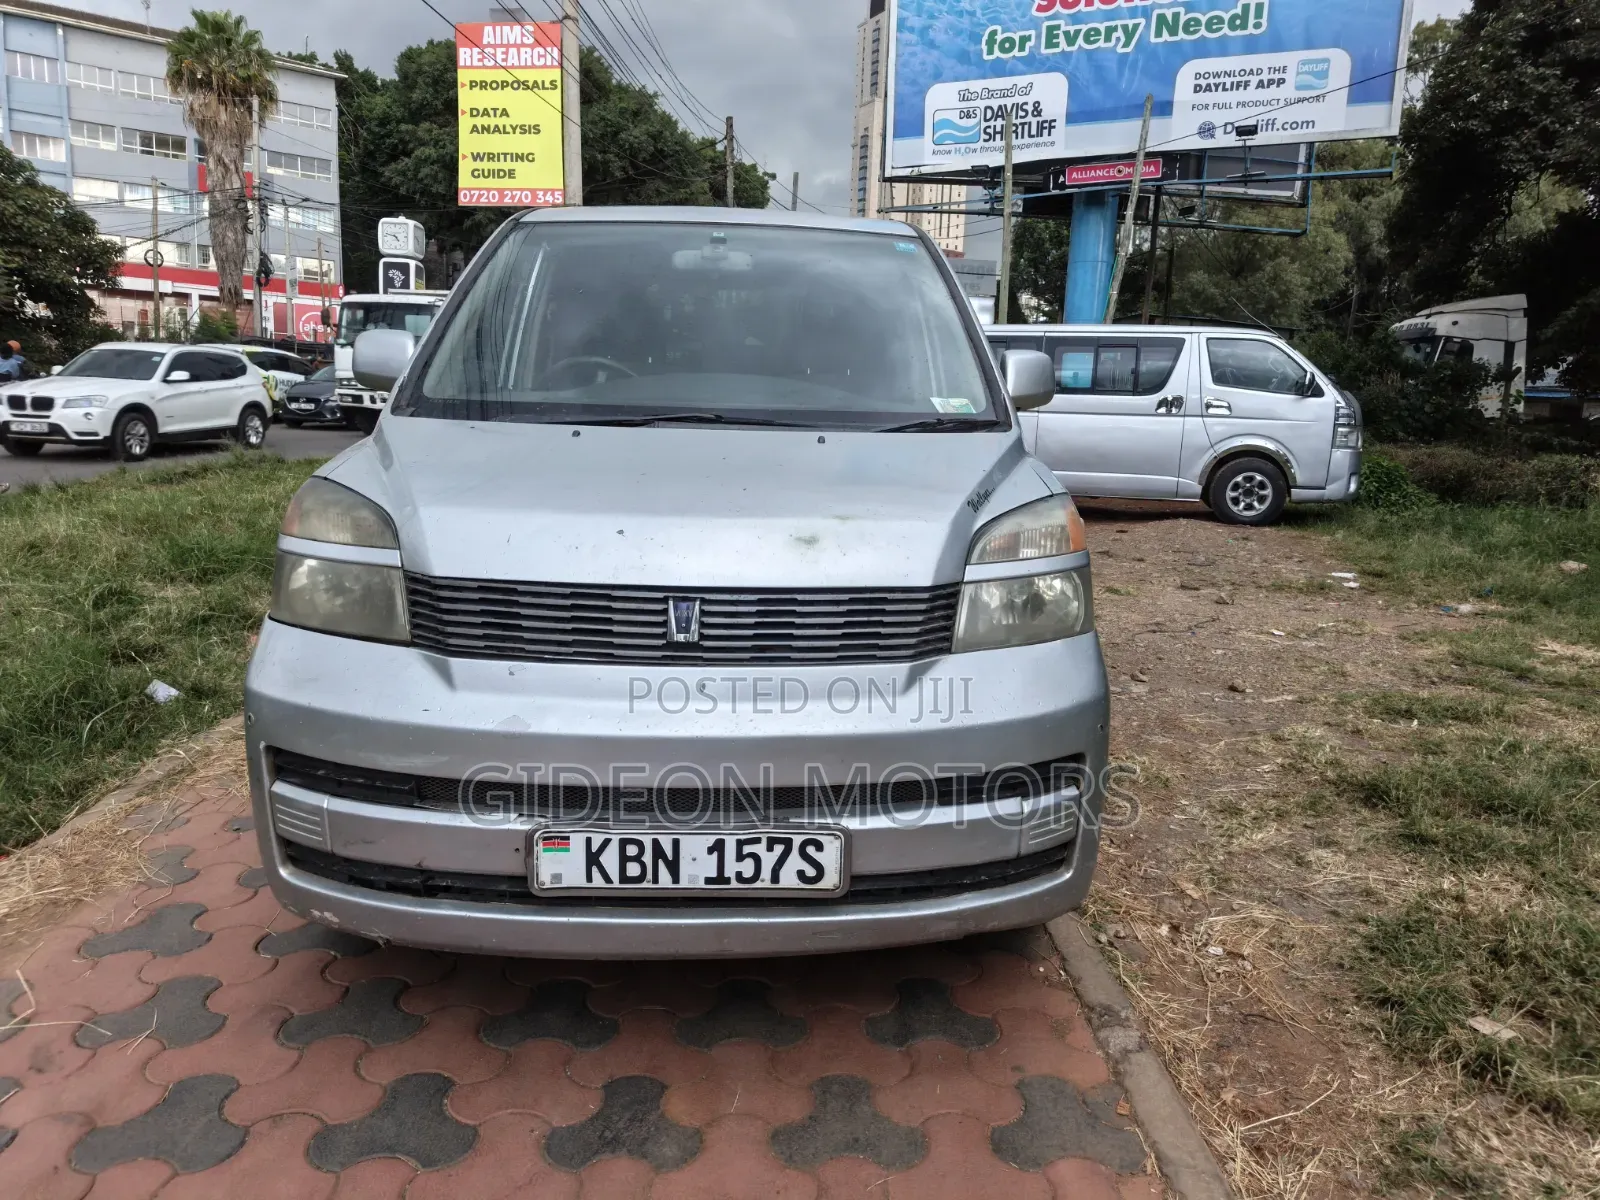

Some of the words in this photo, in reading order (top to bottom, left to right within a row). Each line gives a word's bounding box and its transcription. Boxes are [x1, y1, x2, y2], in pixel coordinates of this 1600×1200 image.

[482, 25, 535, 45] AIMS
[985, 29, 1031, 56] for
[1044, 19, 1142, 50] Every
[1154, 2, 1264, 39] Need!
[459, 47, 559, 66] RESEARCH
[1194, 67, 1264, 81] DOWNLOAD
[1267, 65, 1288, 75] THE
[469, 80, 558, 91] PROPOSALS
[958, 88, 979, 102] The
[980, 84, 1017, 101] Brand
[1018, 82, 1033, 96] of
[1193, 80, 1251, 94] DAYLIFF
[1255, 77, 1286, 90] APP
[1192, 102, 1210, 111] FOR
[1213, 101, 1233, 110] FULL
[1236, 98, 1281, 108] PRODUCT
[1283, 95, 1327, 106] SUPPORT
[469, 107, 510, 118] DATA
[959, 109, 978, 120] D&S
[983, 102, 1029, 123] DAVIS
[1031, 100, 1043, 118] &
[469, 124, 542, 135] ANALYSIS
[1011, 140, 1056, 151] experience
[470, 152, 536, 163] WRITING
[471, 168, 517, 179] GUIDE
[460, 190, 499, 203] 0720
[503, 190, 532, 203] 270
[536, 190, 563, 203] 345
[586, 836, 680, 885] KBN
[704, 836, 825, 885] 157S
